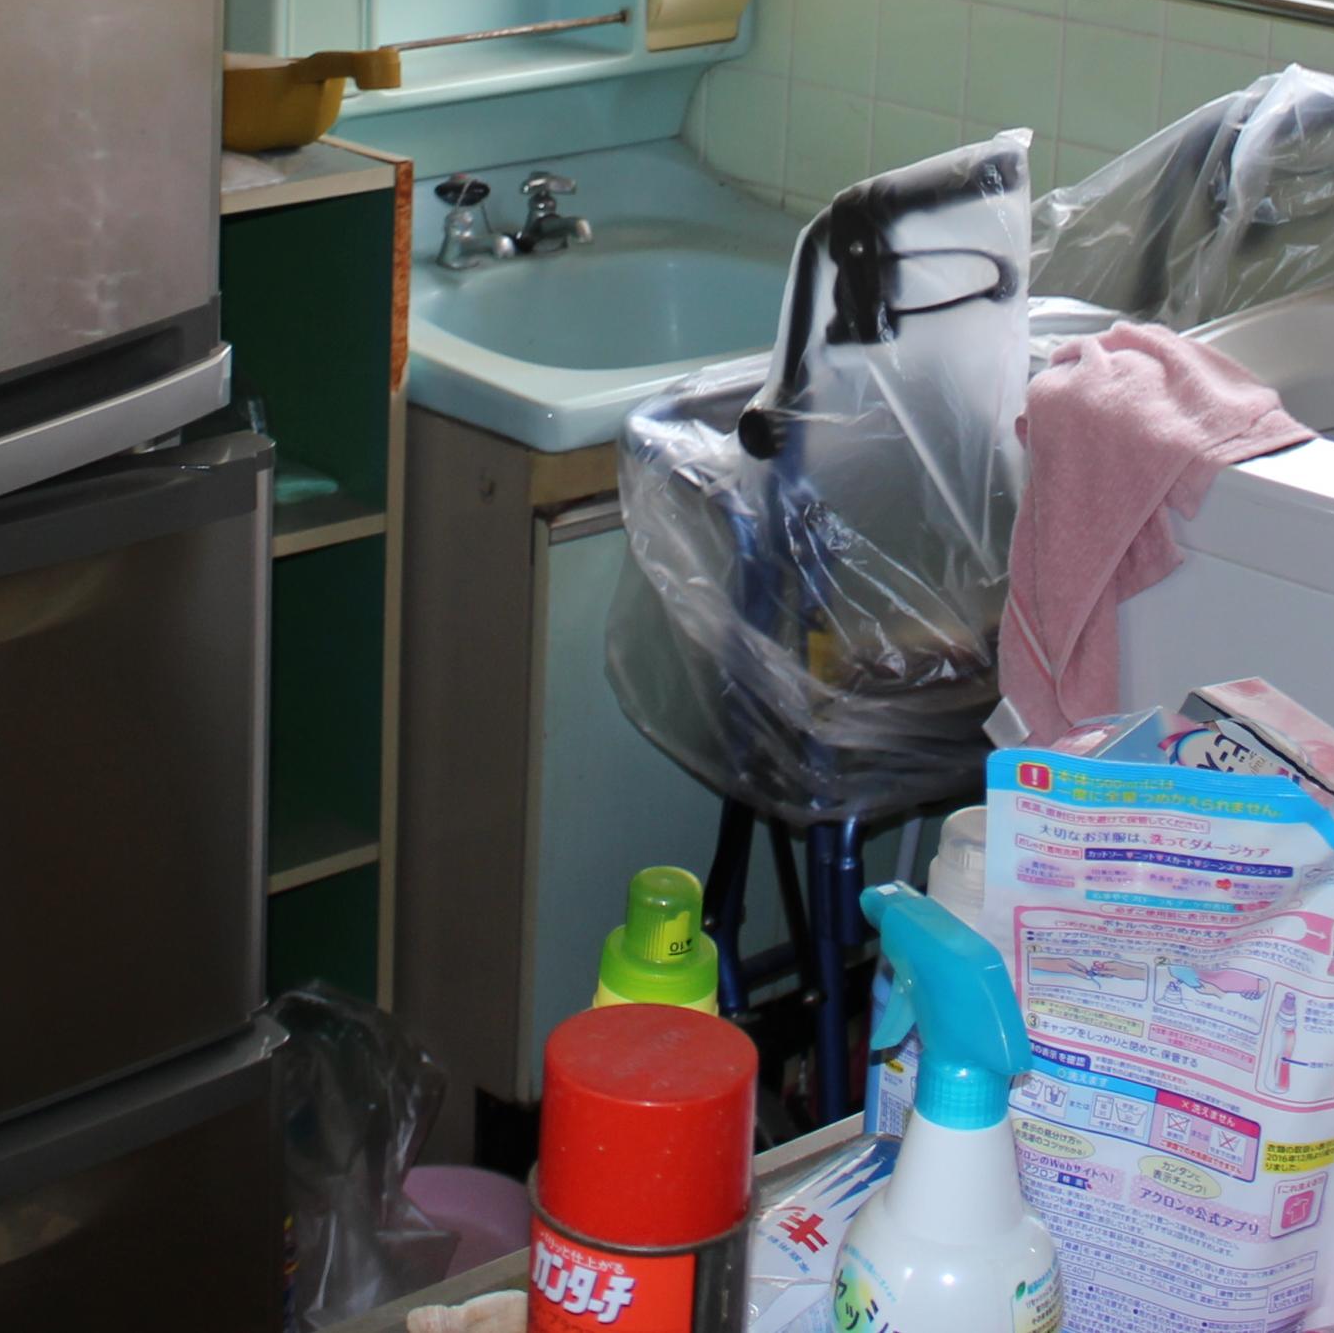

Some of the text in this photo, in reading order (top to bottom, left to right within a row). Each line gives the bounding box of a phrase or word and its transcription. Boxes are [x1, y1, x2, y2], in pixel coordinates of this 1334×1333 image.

[1164, 855, 1196, 867] スカート
[1041, 1018, 1199, 1069] キャップをしっかりと閉めて、保管する
[1153, 1169, 1208, 1196] 表示チェック!
[1139, 1186, 1260, 1236] アクロンの公式アプリ
